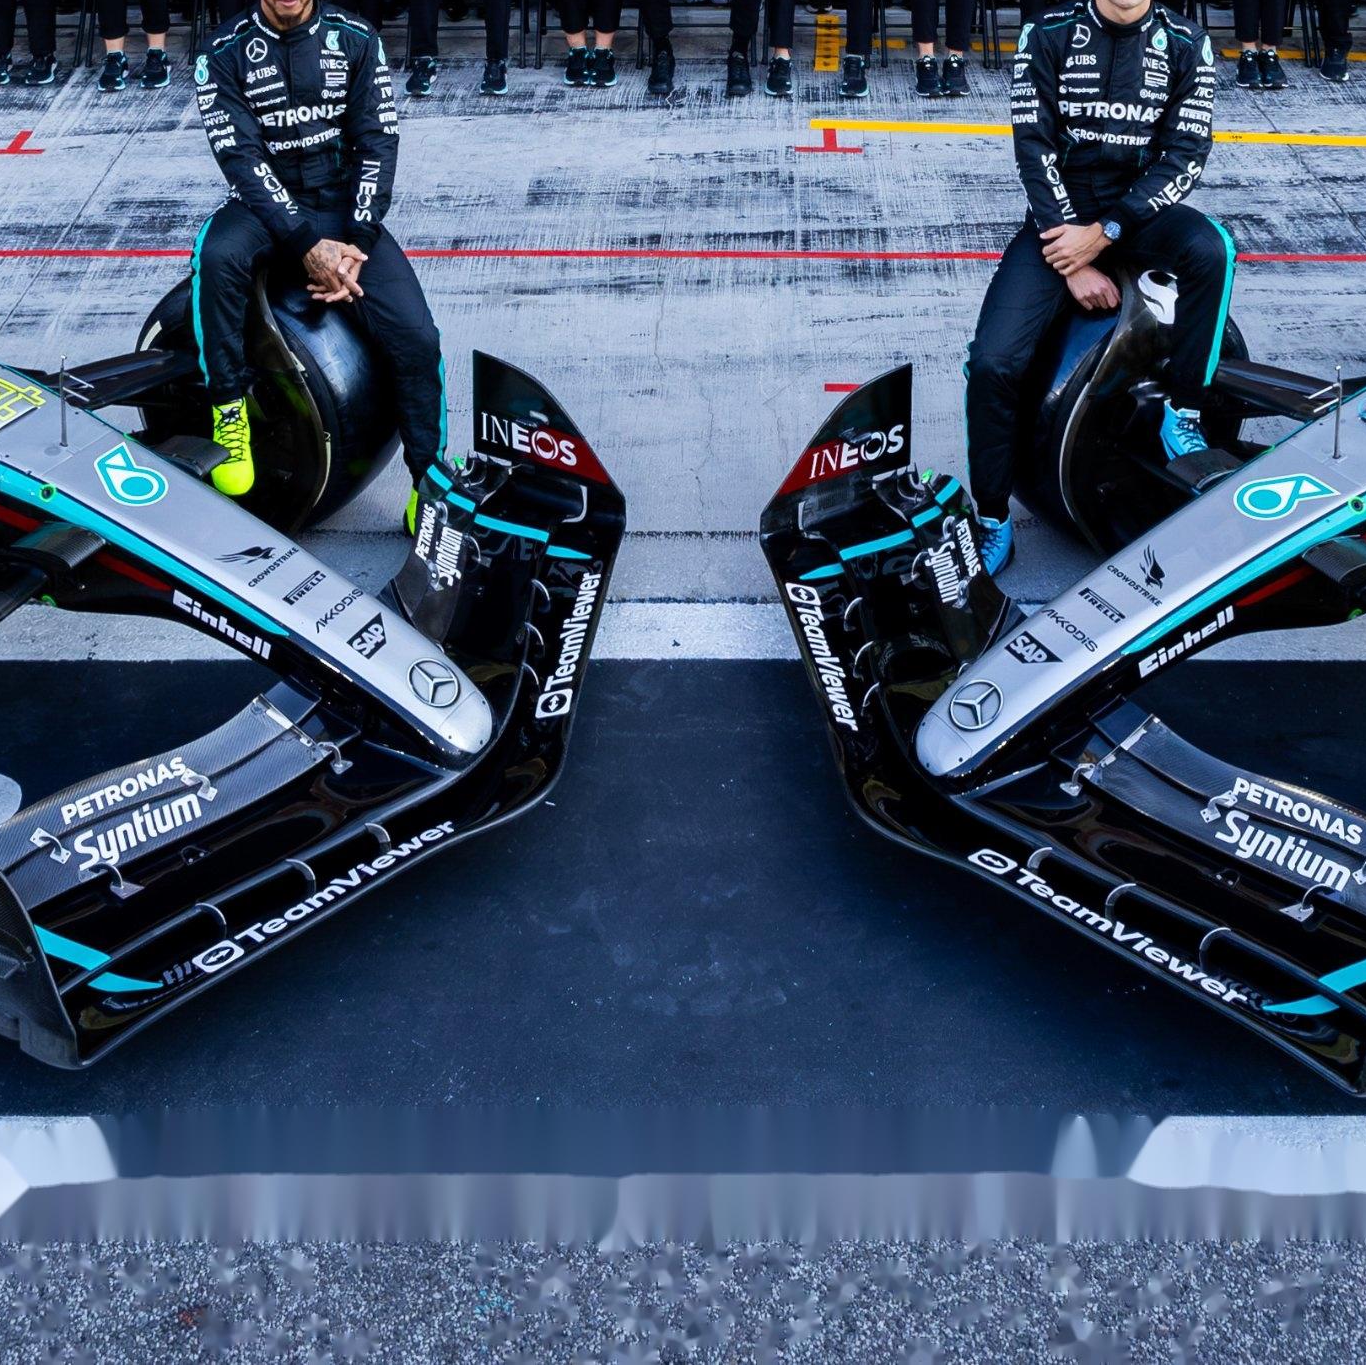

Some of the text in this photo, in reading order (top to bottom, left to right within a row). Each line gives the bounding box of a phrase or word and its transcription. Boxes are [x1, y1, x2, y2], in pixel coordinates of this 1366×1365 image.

[255, 66, 277, 80] UBS
[1075, 55, 1097, 65] UBS
[1058, 100, 1164, 123] PETRONAS
[354, 160, 381, 222] INEOS
[1041, 153, 1077, 221] INEOS
[1148, 161, 1203, 212] INEOS
[481, 412, 577, 467] INEOS
[811, 425, 904, 478] INEOS
[415, 503, 437, 561] PETRONAS
[433, 528, 463, 586] Syntium
[955, 518, 981, 577] PETRONAS
[247, 547, 299, 588] CROWDSTRIKE
[283, 571, 326, 605] PIRELLI
[928, 540, 960, 604] Syntium
[1107, 564, 1163, 607] CROWDSTRIKE
[171, 590, 271, 660] Einhell
[316, 588, 364, 633] AKKODIS
[546, 572, 601, 688] TeamViewer
[1041, 608, 1098, 652] AKKODIS
[1079, 588, 1125, 624] PIRELLI
[352, 622, 384, 656] SAP
[801, 606, 858, 730] TeamViewer
[1011, 634, 1046, 663] SAP
[1139, 606, 1234, 676] Einhell
[60, 756, 188, 825] PETRONAS
[1233, 777, 1362, 844] PETRONAS
[72, 792, 202, 873] Syntium
[1215, 812, 1353, 891] Syntium
[236, 820, 455, 945] TeamViewer
[1015, 867, 1249, 1006] TeamViewer
